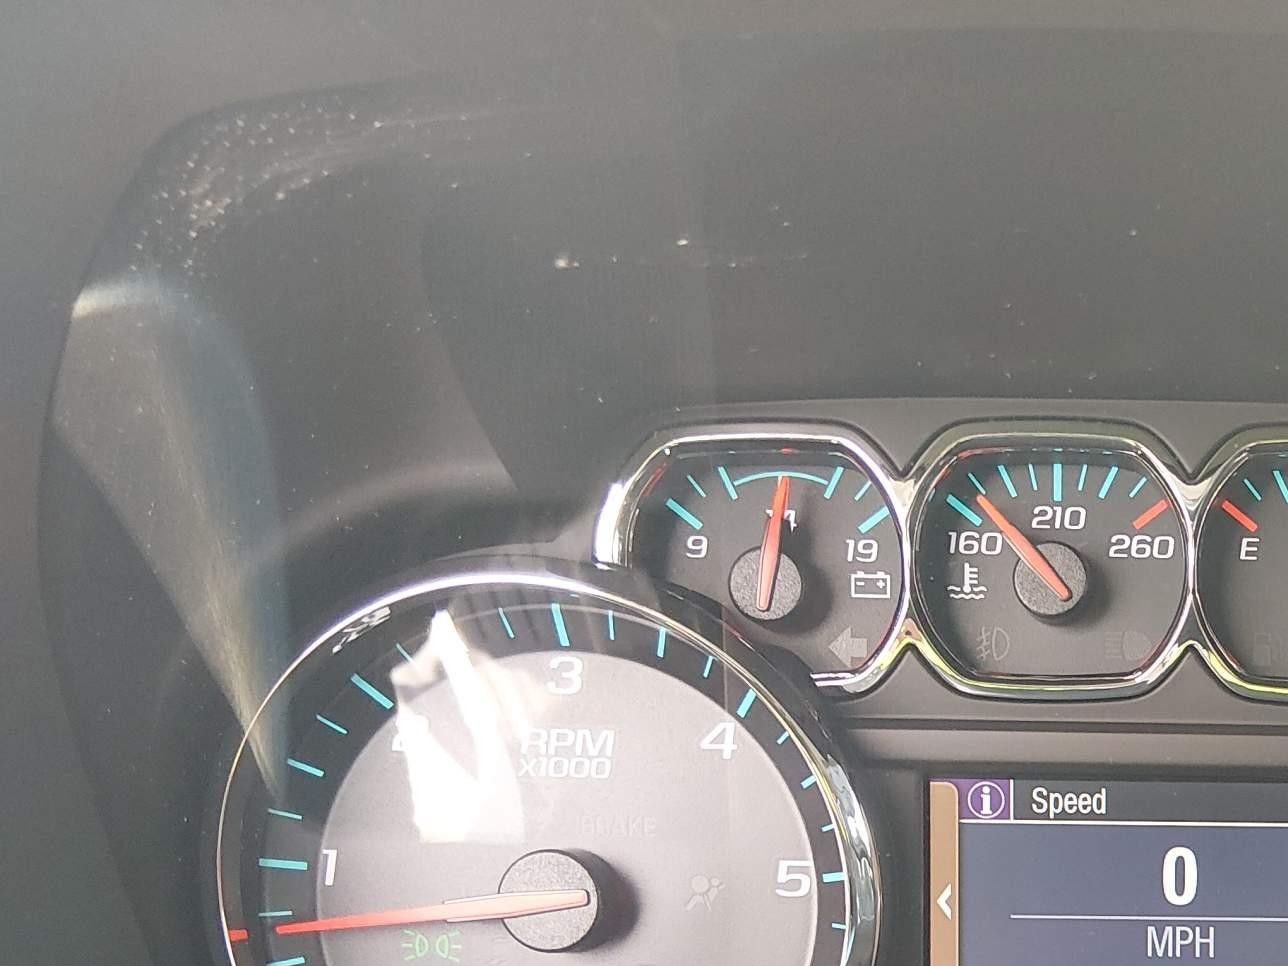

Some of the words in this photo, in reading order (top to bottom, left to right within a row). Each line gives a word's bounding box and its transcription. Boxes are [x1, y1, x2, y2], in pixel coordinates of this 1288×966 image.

[1031, 505, 1087, 530] 210
[686, 535, 708, 558] 9
[845, 539, 878, 563] 19
[948, 530, 1003, 555] 160
[1108, 534, 1175, 559] 260
[1239, 537, 1260, 561] E
[547, 656, 584, 695] 3
[520, 728, 616, 757] RPM
[700, 720, 739, 760] 4
[1030, 787, 1108, 818] Speed
[321, 848, 339, 886] 1
[775, 858, 812, 897] 5
[1162, 846, 1198, 906] 0
[1147, 925, 1215, 958] MPH
